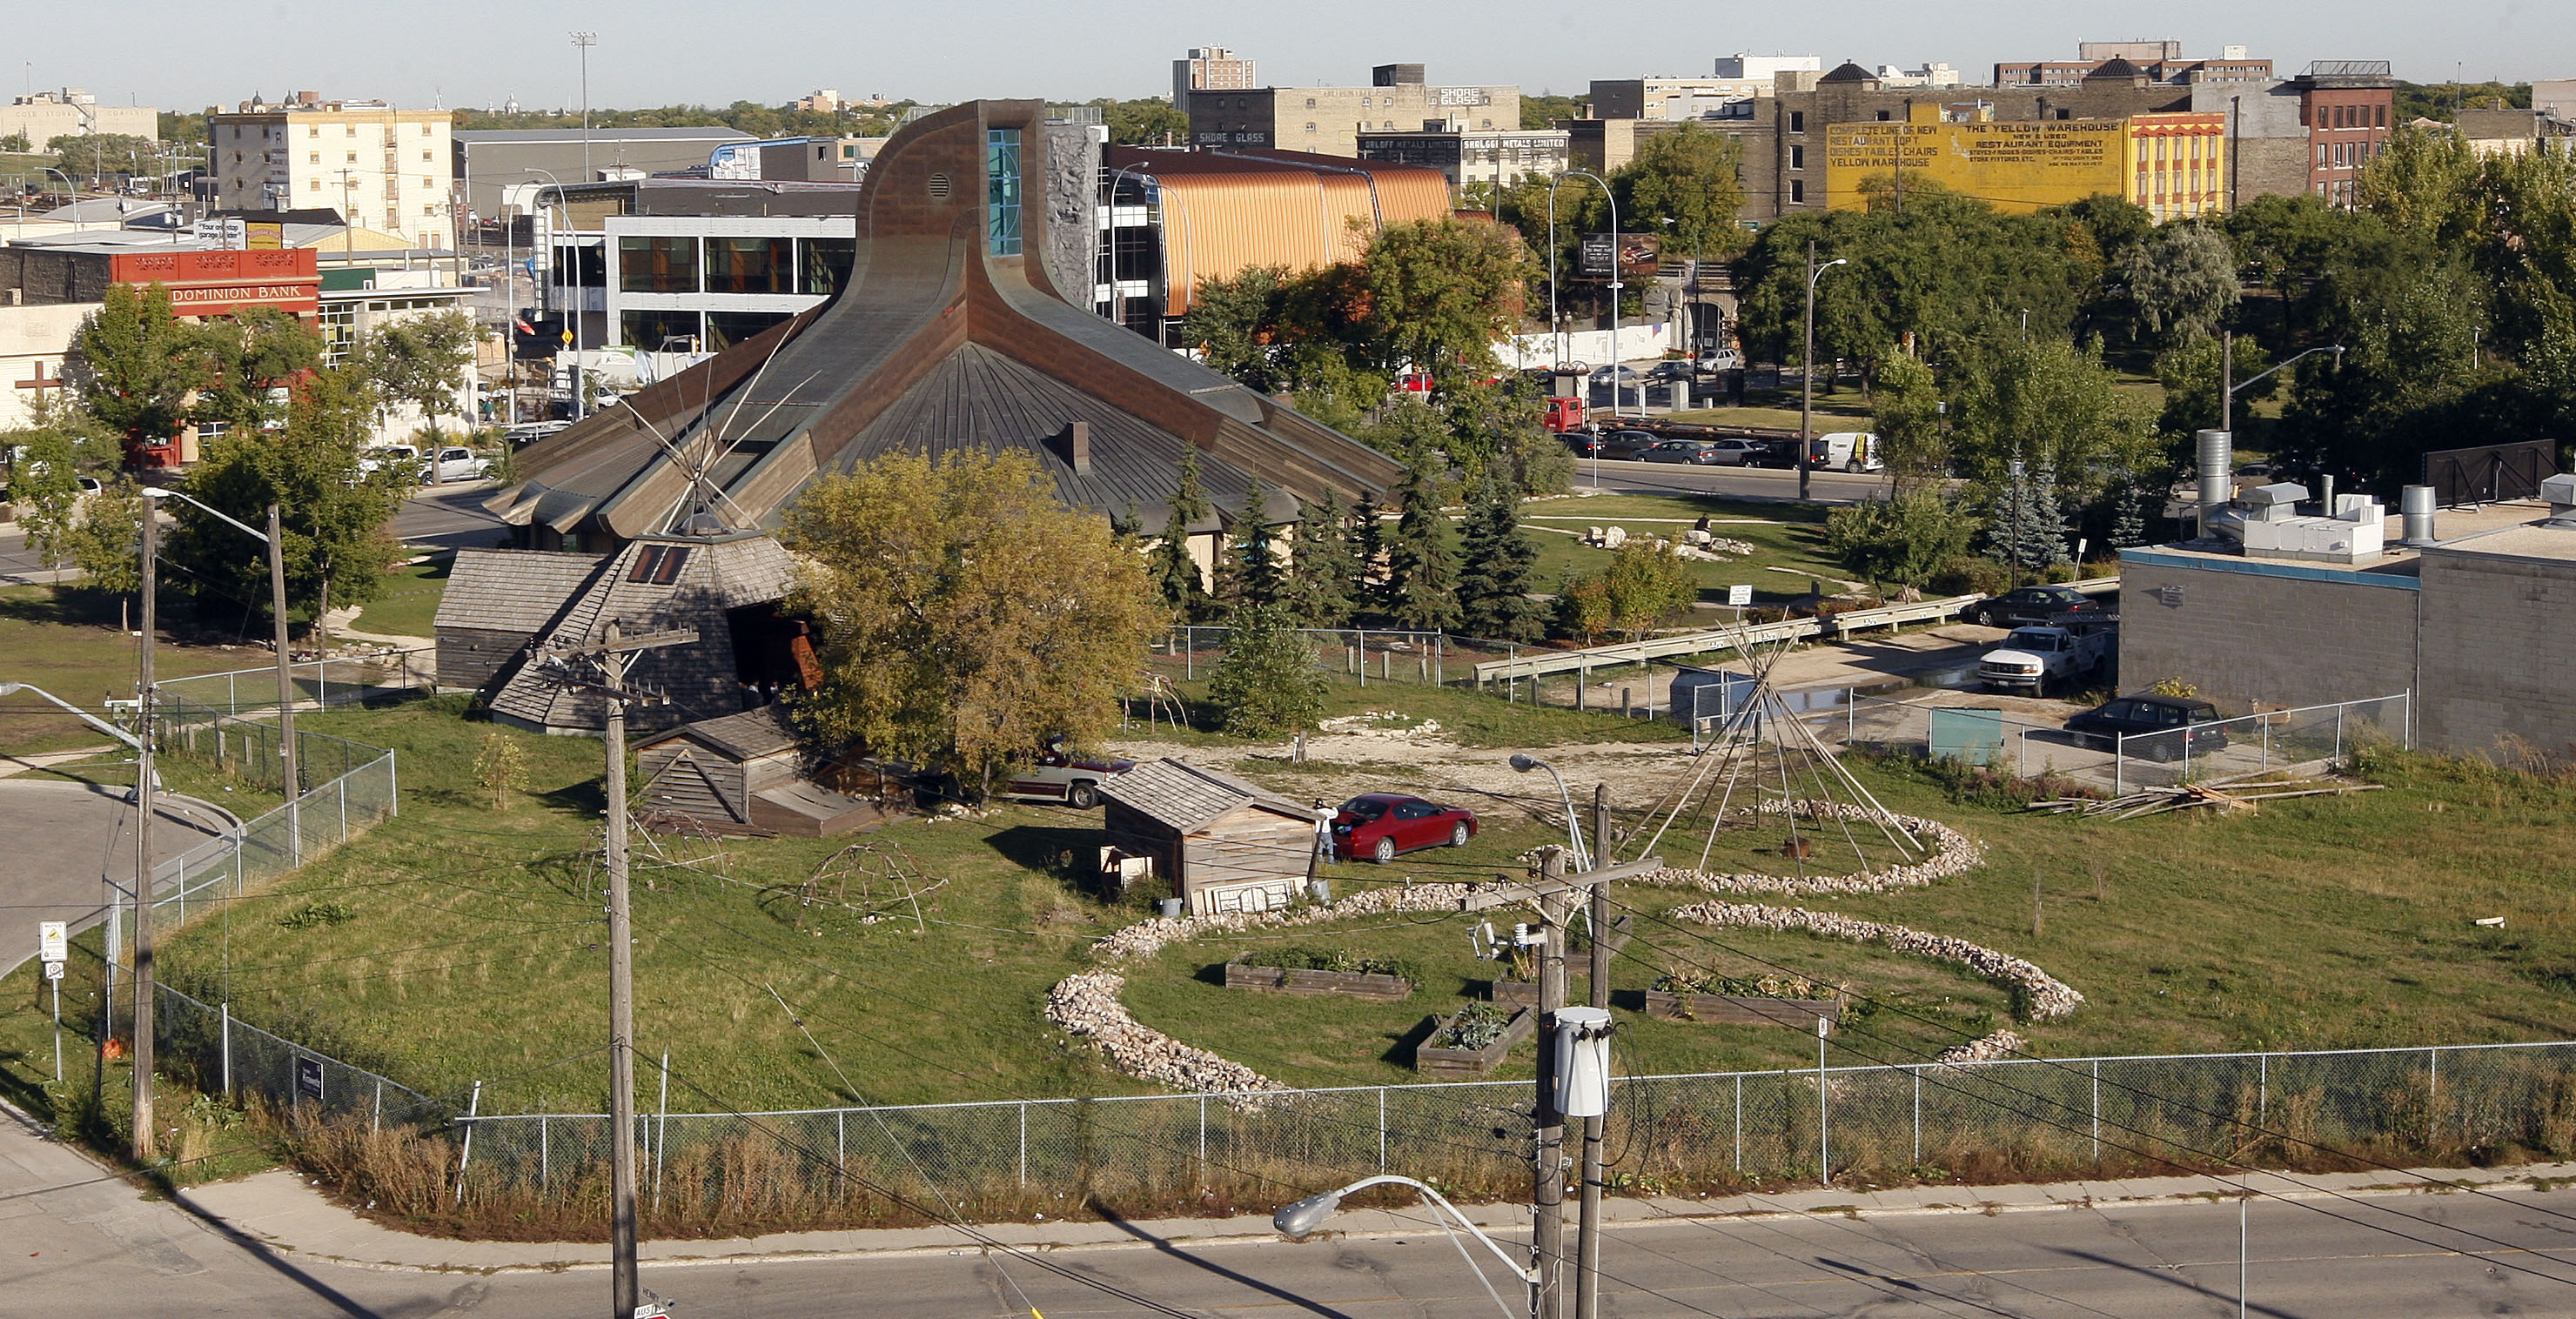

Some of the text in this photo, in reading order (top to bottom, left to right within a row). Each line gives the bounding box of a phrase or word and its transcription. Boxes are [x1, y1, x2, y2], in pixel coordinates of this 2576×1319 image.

[1440, 97, 1479, 105] GLASS
[1881, 125, 1901, 135] LINE
[1902, 125, 1915, 135] OF
[1917, 125, 1937, 135] NEW
[1965, 123, 2119, 133] THE YELLOW WAREHOUSE
[1199, 132, 1265, 143] SHORE GLASS
[1502, 139, 1532, 148] METALS
[1533, 138, 1565, 148] LIMITED
[2048, 139, 2103, 148] EQUIPMENT
[1830, 157, 1868, 167] YELLOW
[172, 285, 301, 302] DOMINION BANK
